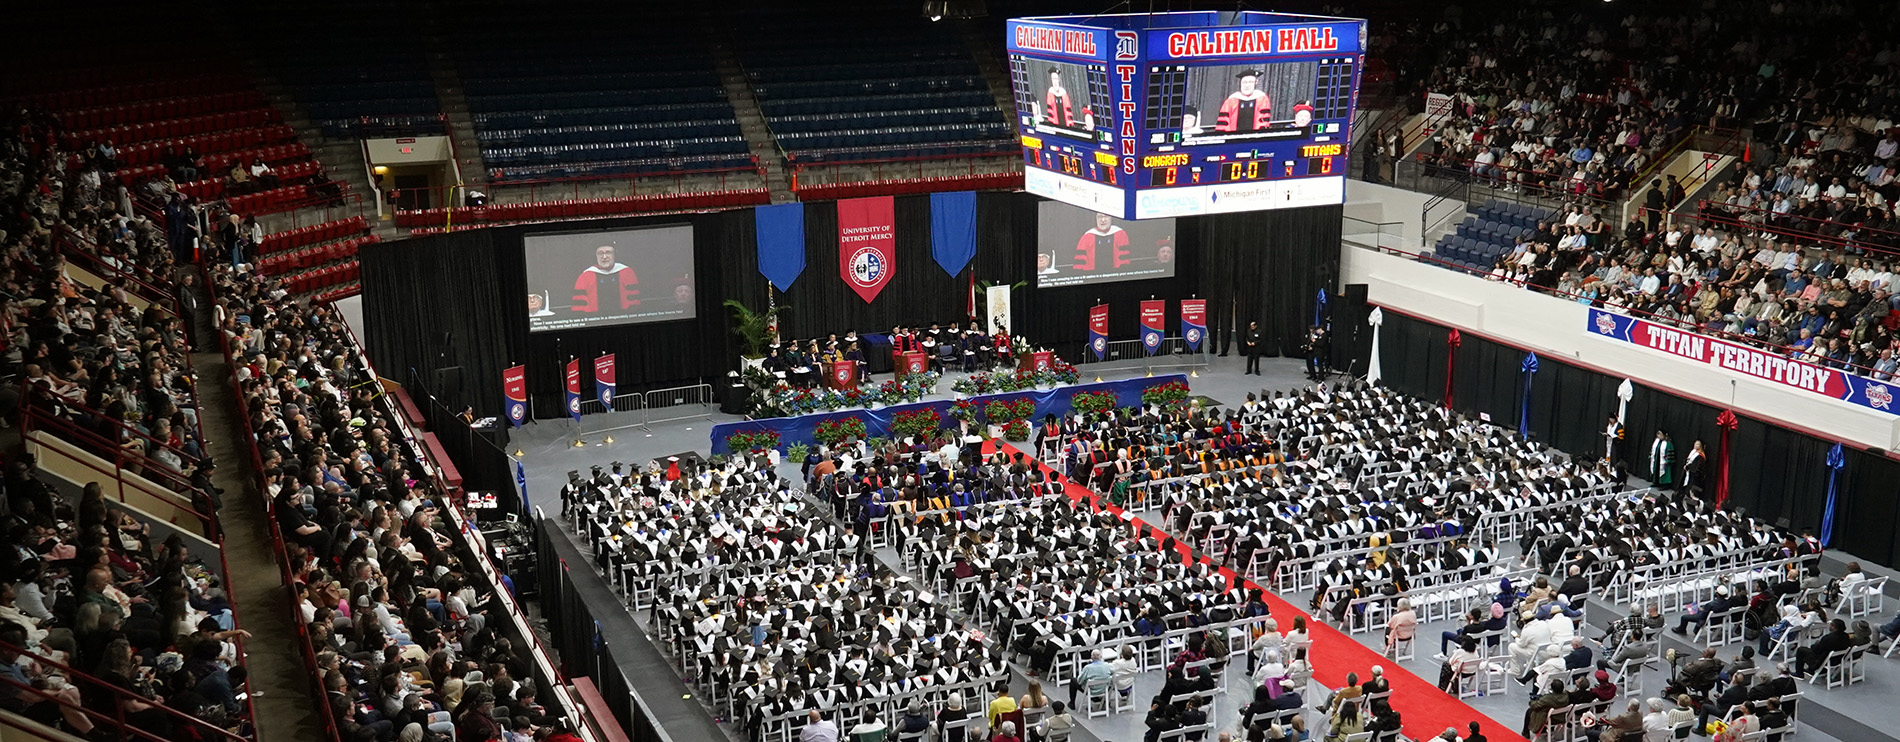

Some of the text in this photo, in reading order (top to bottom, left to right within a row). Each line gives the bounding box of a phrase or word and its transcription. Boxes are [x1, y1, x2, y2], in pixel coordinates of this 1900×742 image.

[1016, 25, 1096, 56] CALIHAN HALL
[1168, 27, 1338, 58] CALIHAN HALL
[1116, 65, 1138, 174] TITANS
[1302, 144, 1341, 157] TITANS
[1144, 154, 1188, 168] CONGRATS
[1321, 156, 1332, 174] 0
[1166, 167, 1176, 185] 0
[1224, 190, 1254, 199] Michigan
[1256, 188, 1271, 196] First
[842, 226, 880, 235] UNIVERSITY
[842, 234, 870, 242] DETROIT
